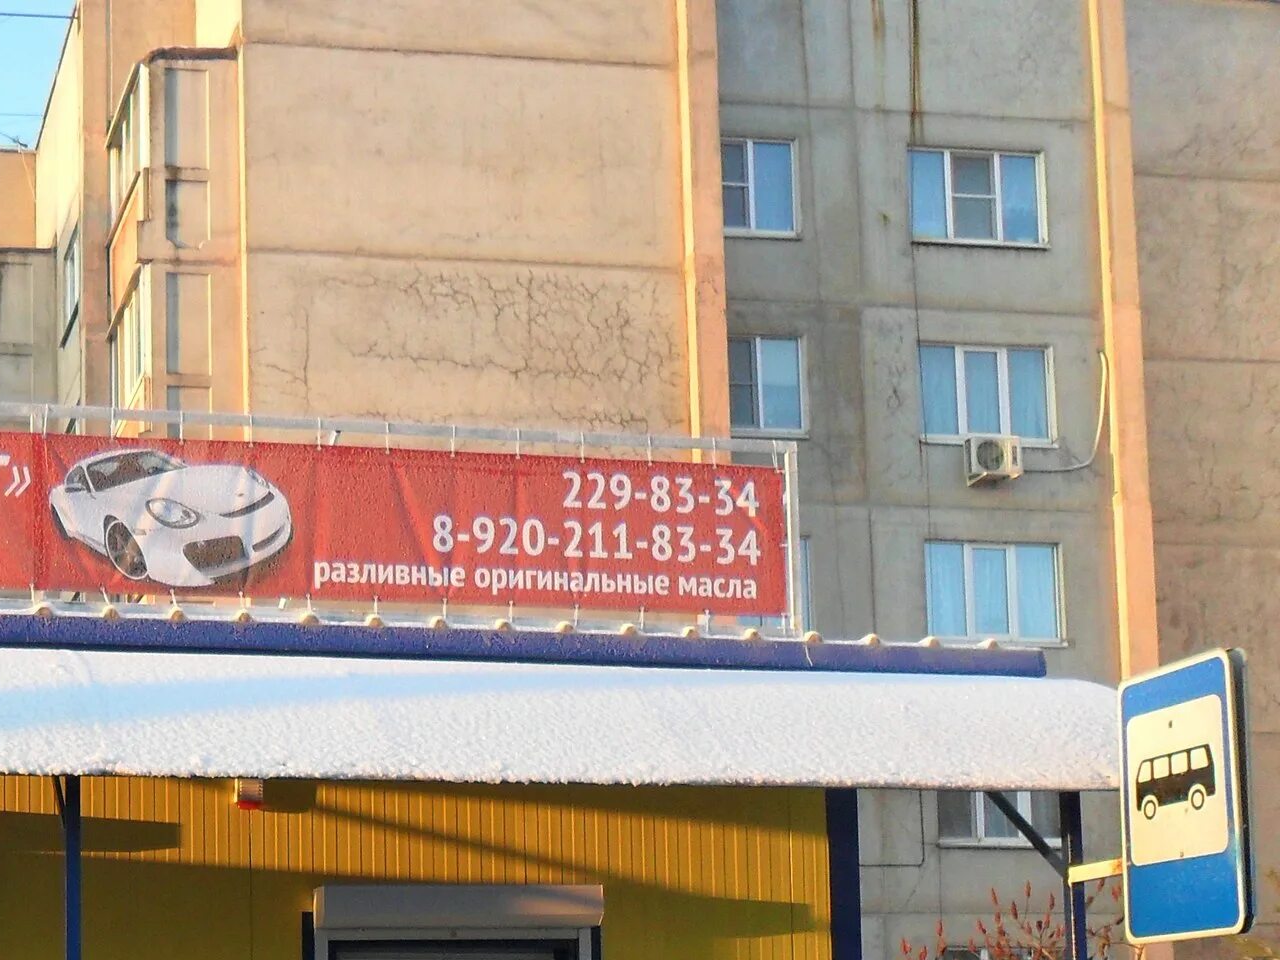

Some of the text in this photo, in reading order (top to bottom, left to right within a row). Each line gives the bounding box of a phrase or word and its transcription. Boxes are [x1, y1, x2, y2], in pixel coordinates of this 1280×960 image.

[562, 468, 760, 518] 229-83-34
[432, 514, 762, 566] 8-920-211-83-34
[313, 559, 757, 600] разливные оригинальные масла
